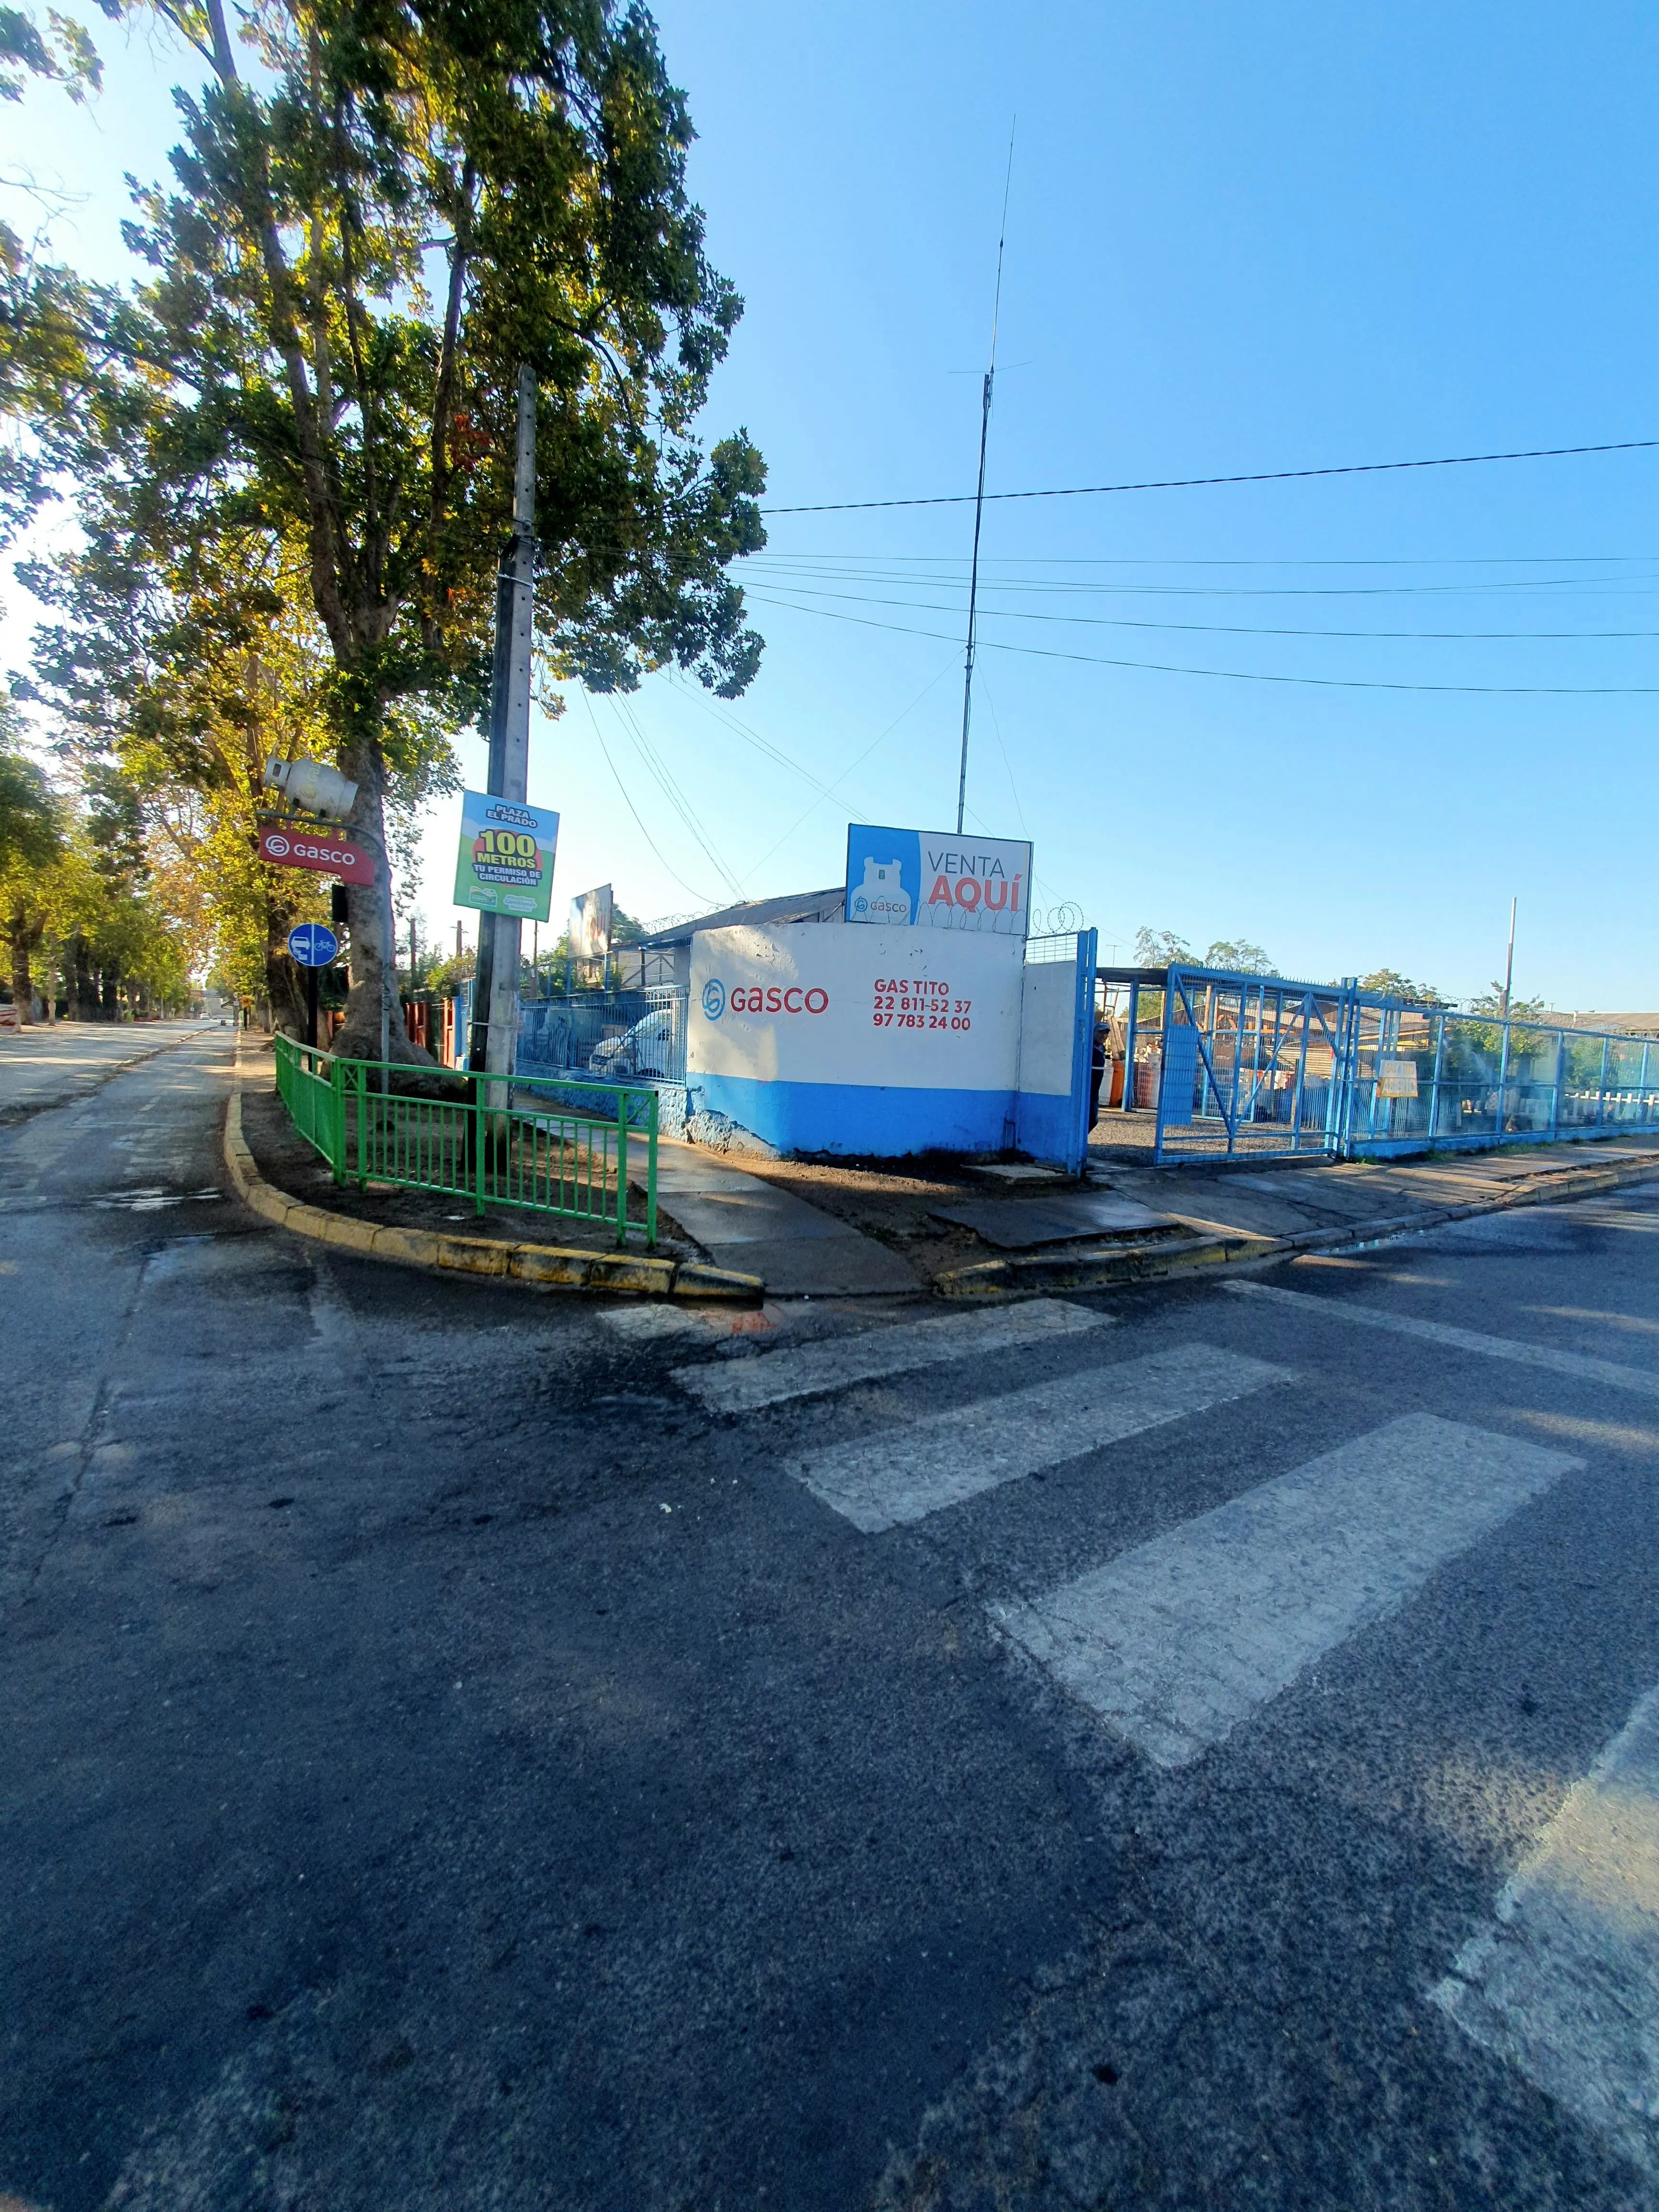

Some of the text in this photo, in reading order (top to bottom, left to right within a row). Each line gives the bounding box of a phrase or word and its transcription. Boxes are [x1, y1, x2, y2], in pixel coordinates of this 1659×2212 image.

[487, 811, 537, 828] EL PRADO
[496, 805, 529, 819] PLAZA
[481, 830, 535, 857] 100
[477, 853, 535, 868] METROS
[928, 851, 1005, 878] VENTA
[480, 873, 536, 885] CIRCULACIÓN
[488, 866, 527, 877] PERMISO
[928, 874, 1022, 913] AQUÍ
[874, 979, 949, 995] GAS TITO
[874, 996, 972, 1014] 22 811 52 37
[873, 1013, 971, 1031] 97 783 24 00
